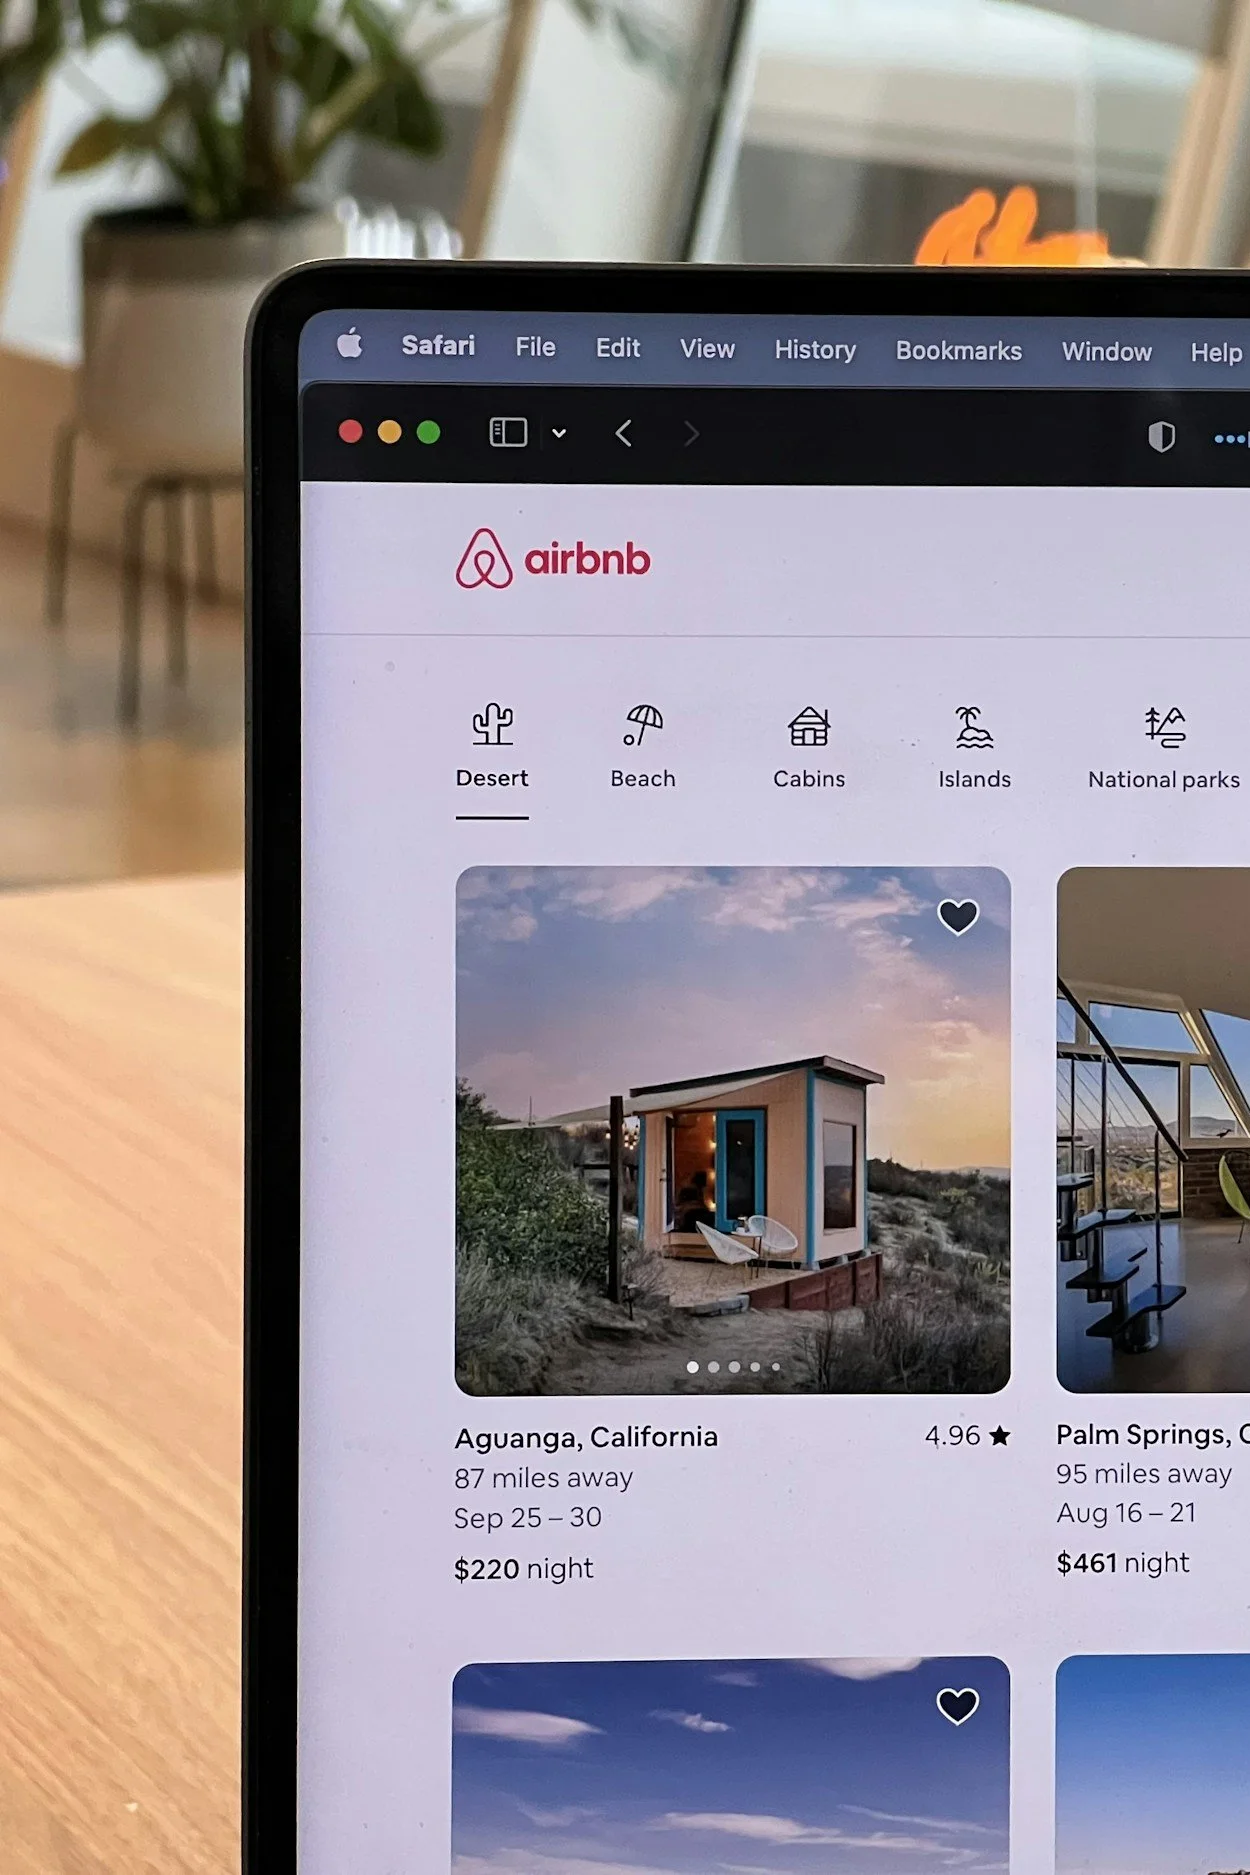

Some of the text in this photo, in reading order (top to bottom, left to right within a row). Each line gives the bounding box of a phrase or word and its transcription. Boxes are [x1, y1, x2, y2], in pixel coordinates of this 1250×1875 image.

[402, 334, 475, 357] Safari
[516, 335, 556, 357] File
[596, 336, 641, 359] Edit
[680, 337, 736, 360] View
[775, 338, 857, 364] History
[896, 339, 1023, 362] Bookmarks
[1062, 340, 1153, 363] Window
[1191, 342, 1243, 367] Help
[524, 540, 651, 575] airbnb
[456, 769, 530, 787] Desert
[611, 768, 676, 787] Beach
[773, 769, 846, 788] Cabins
[939, 769, 1012, 788] Islands
[1089, 769, 1241, 793] National parks
[454, 1424, 718, 1455] Aguanga, California
[924, 1424, 981, 1446] 4.96
[1057, 1422, 1120, 1446] Palm
[1126, 1423, 1232, 1451] Springs,
[454, 1465, 634, 1493] 87 miles away
[1056, 1461, 1233, 1490] 95 miles away
[454, 1507, 504, 1535] Sep
[510, 1506, 542, 1529] 25
[569, 1506, 602, 1528] 30
[1056, 1502, 1108, 1529] Aug
[1115, 1502, 1143, 1523] 16
[1170, 1501, 1195, 1523] 21
[454, 1555, 595, 1585] $220 night
[1057, 1549, 1191, 1579] $461 night
